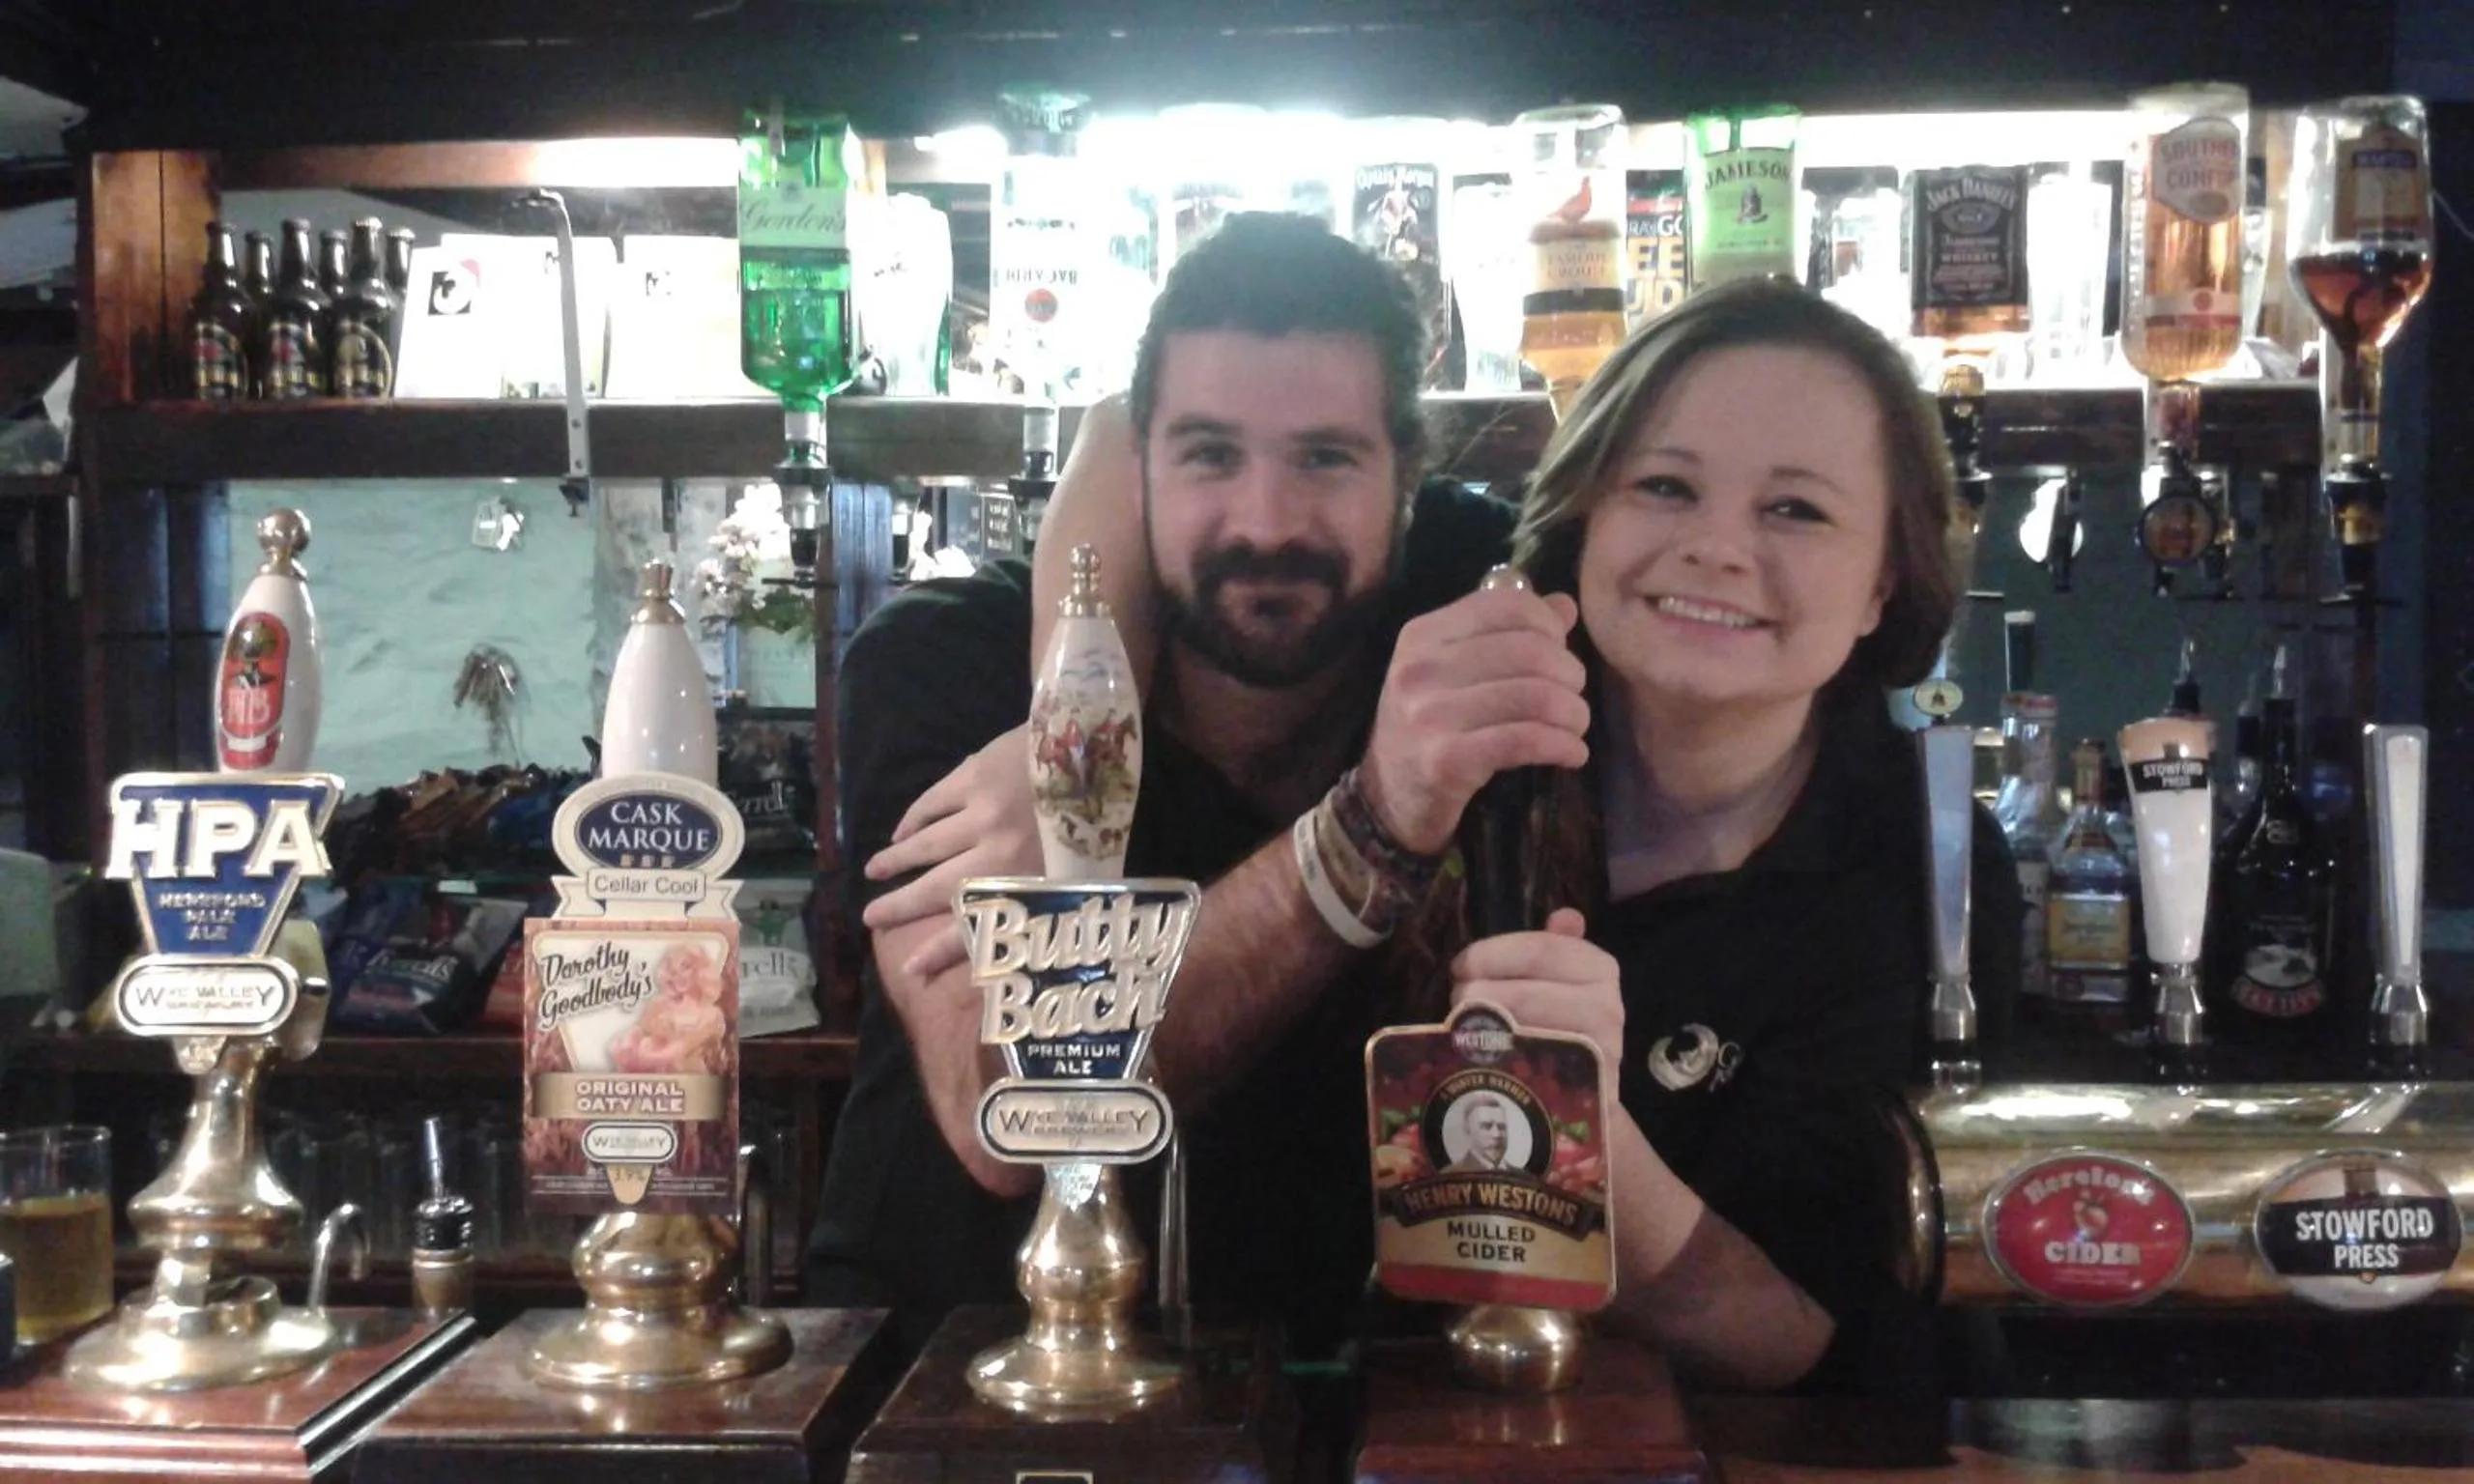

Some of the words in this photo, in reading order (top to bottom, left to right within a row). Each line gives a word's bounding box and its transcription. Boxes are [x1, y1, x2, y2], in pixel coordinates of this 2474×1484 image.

[1705, 160, 1790, 190] JAMESON
[610, 801, 683, 824] CASK
[104, 799, 331, 880] HPA
[588, 826, 710, 853] MARQUE
[594, 872, 647, 893] Cellar
[655, 876, 699, 895] Cool
[187, 925, 228, 940] ALE
[963, 893, 1186, 980] Butty
[541, 940, 630, 986] Dorothy
[541, 961, 653, 1022] Goodbody's
[981, 966, 1166, 1044] Bach
[1027, 1043, 1121, 1058] PREMIUM
[1053, 1060, 1092, 1074] ALE
[577, 1080, 684, 1097] ORIGINAL
[578, 1097, 637, 1113] OATY
[641, 1097, 684, 1113] ALE
[1063, 1108, 1148, 1133] VALLEY
[1404, 1182, 1473, 1213] HENRY
[1476, 1182, 1581, 1226] WESTONS
[1447, 1220, 1537, 1243] MULLED
[2296, 1208, 2434, 1241] STOWFORD
[1456, 1241, 1527, 1263] CIDER
[2044, 1241, 2142, 1266] CIDER
[2334, 1243, 2400, 1270] PRESS
